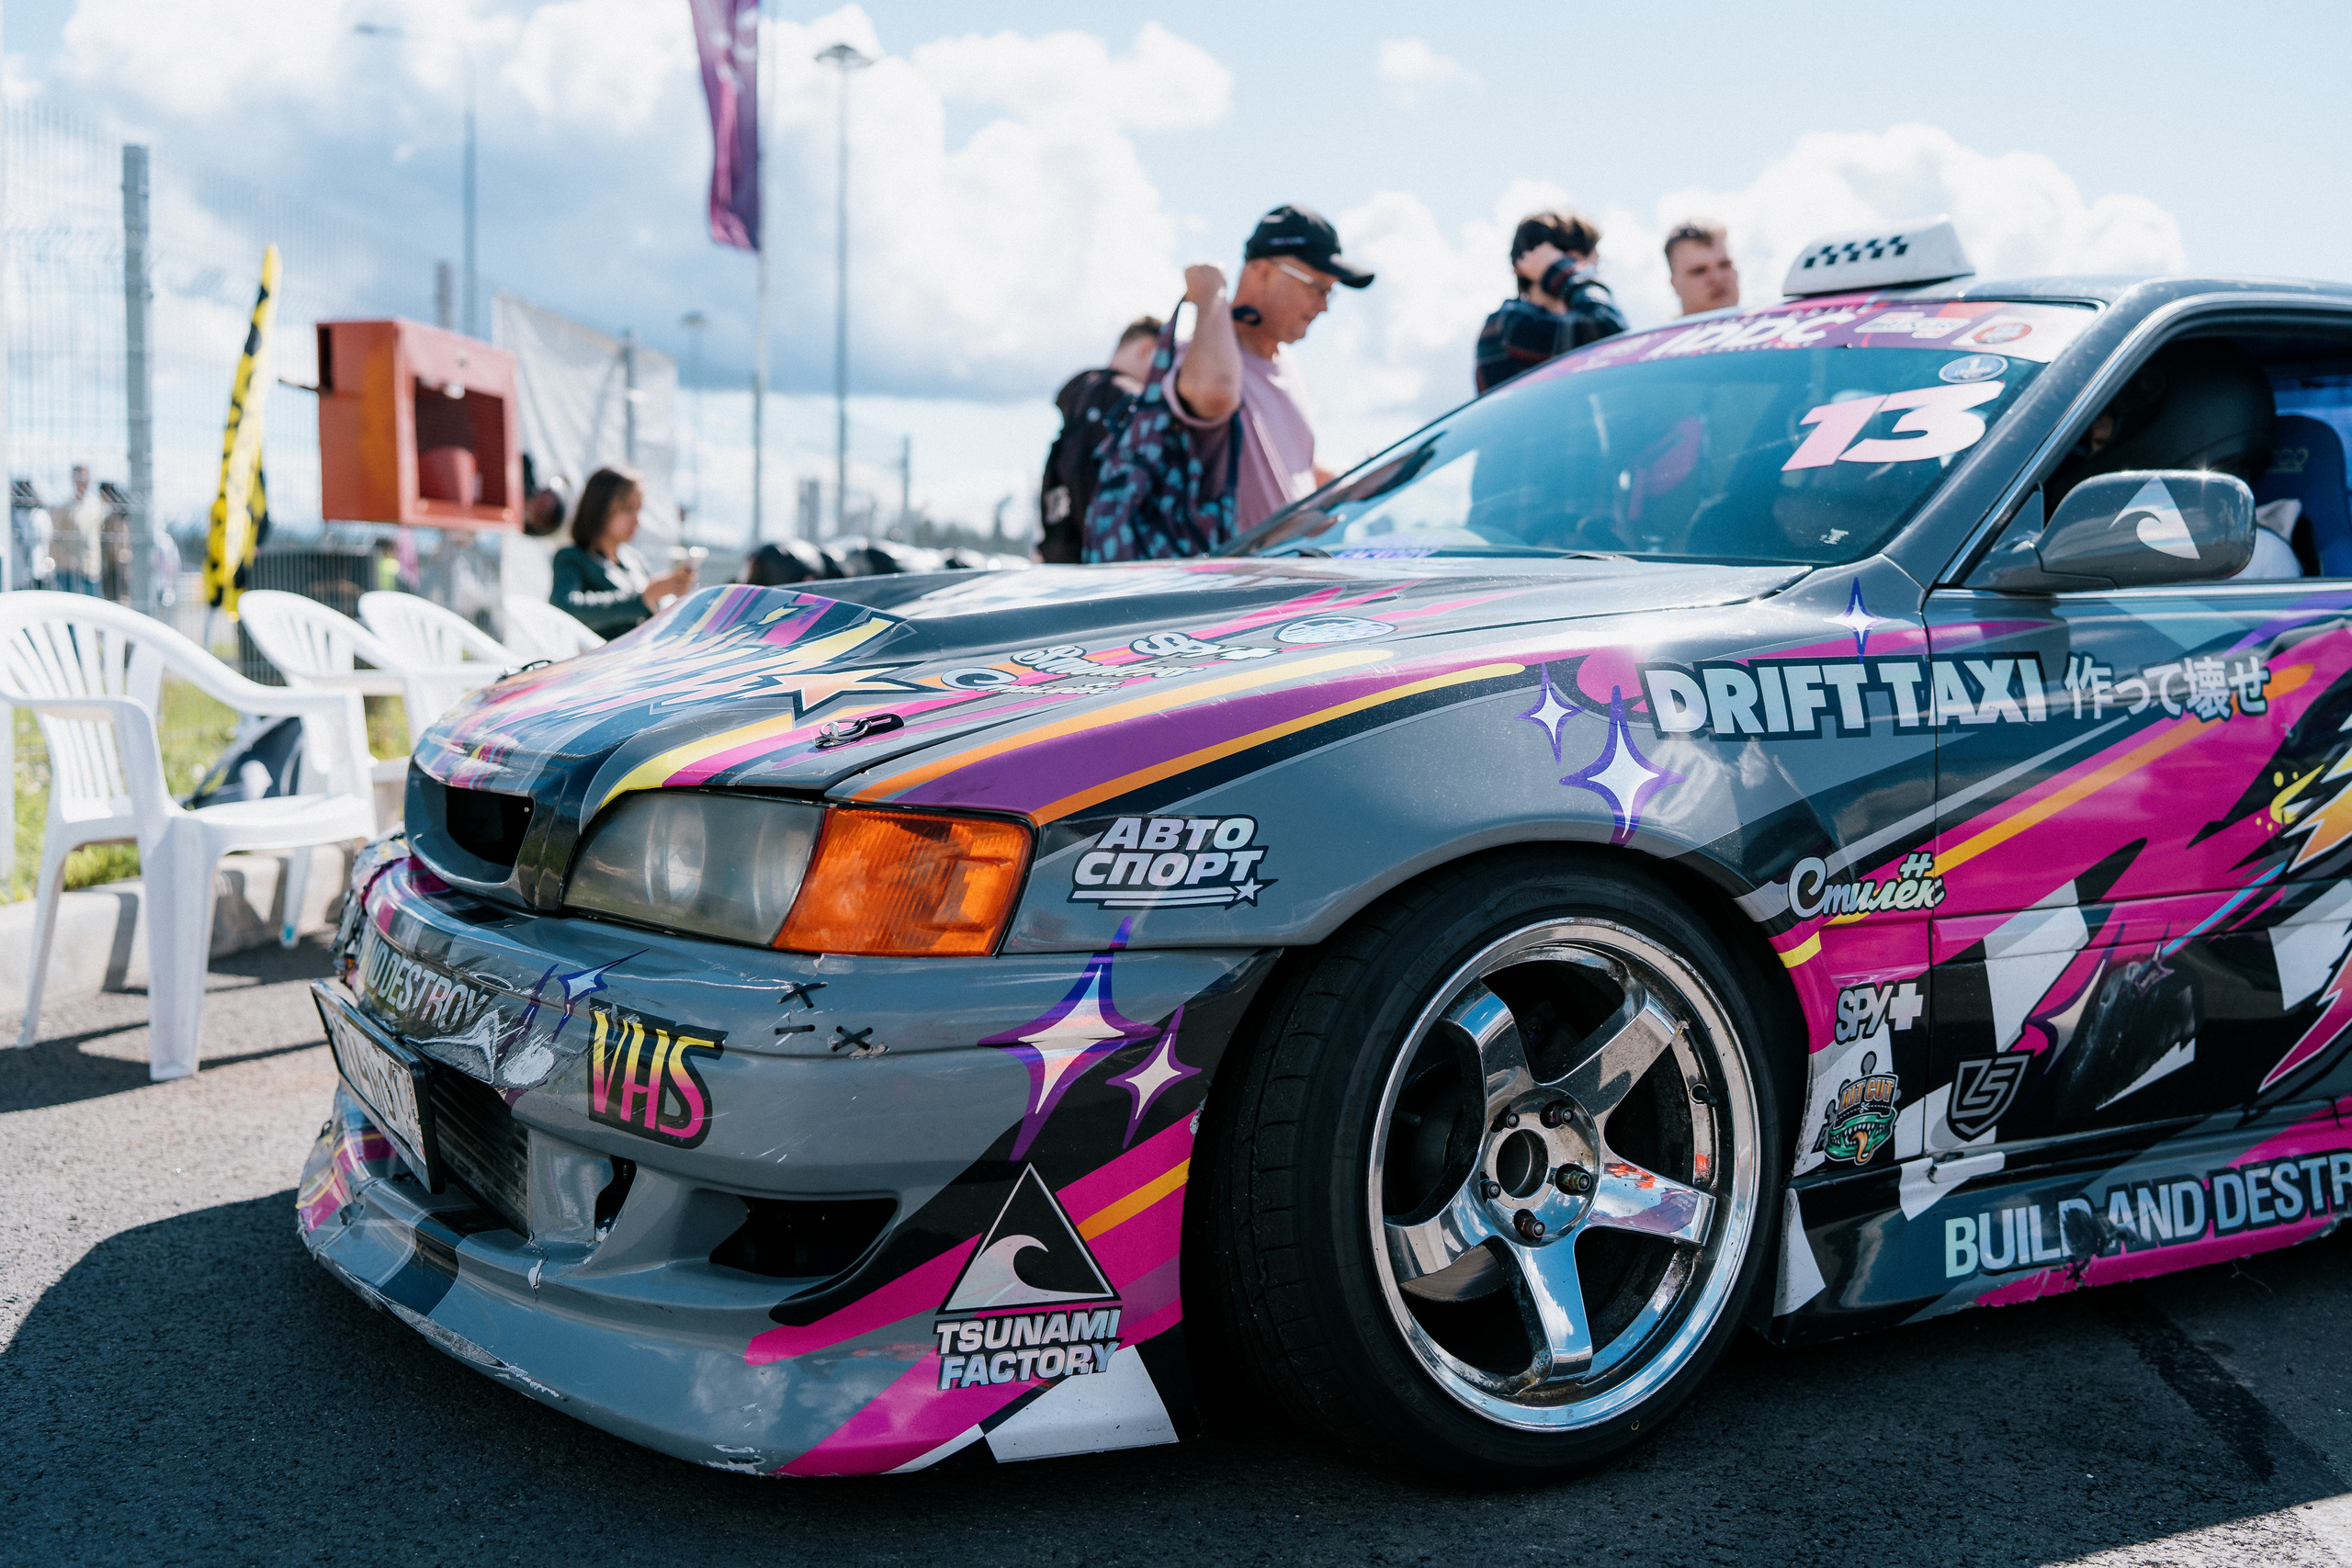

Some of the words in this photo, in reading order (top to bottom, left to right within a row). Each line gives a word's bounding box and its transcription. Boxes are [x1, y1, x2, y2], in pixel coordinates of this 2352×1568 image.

[1781, 380, 2005, 471] 13
[1645, 663, 1868, 734] DRIFT
[1876, 659, 2047, 728] TAXI
[2064, 656, 2269, 720] 作って壊せ
[1097, 817, 1255, 851] АВТО
[1074, 850, 1264, 886] СПОРТ
[378, 952, 489, 1032] DESTROY
[592, 1010, 716, 1139] VHS
[1865, 1077, 1894, 1102] CUT
[2107, 1180, 2204, 1248] AND
[936, 1309, 1122, 1355] TSUNAMI
[941, 1341, 1120, 1391] FACTORY
